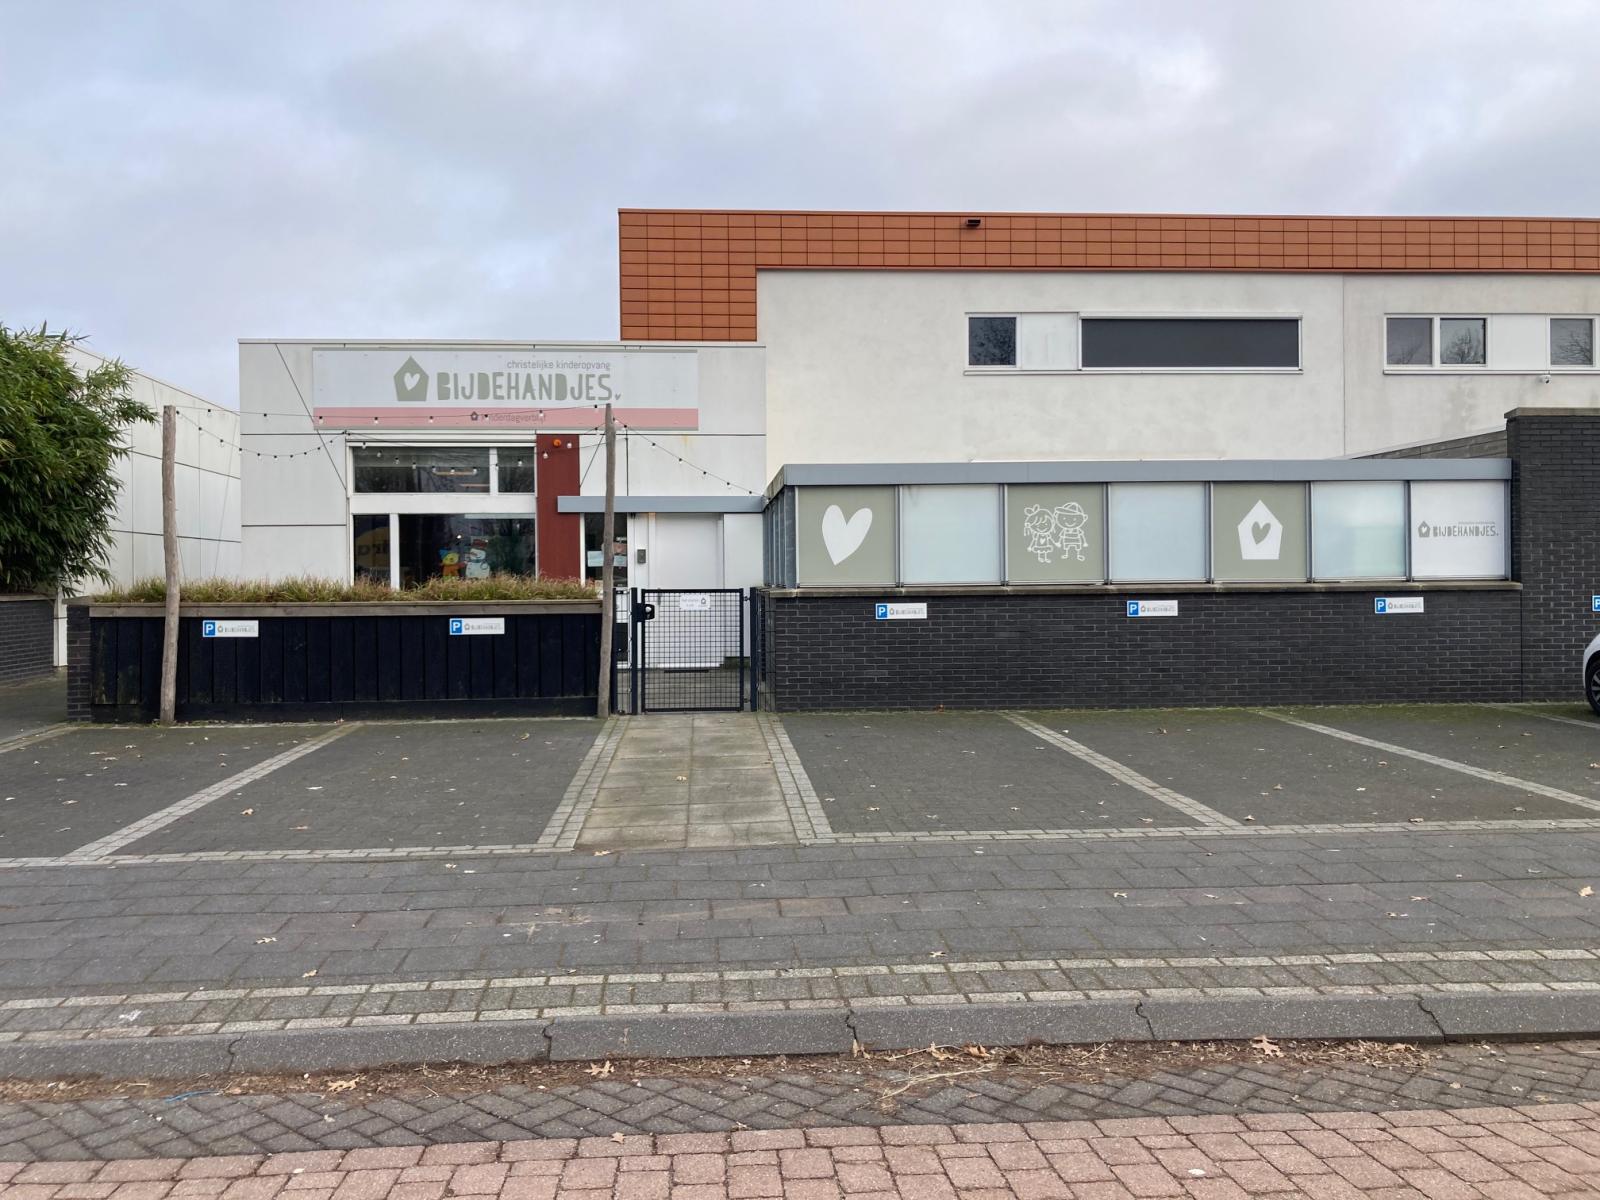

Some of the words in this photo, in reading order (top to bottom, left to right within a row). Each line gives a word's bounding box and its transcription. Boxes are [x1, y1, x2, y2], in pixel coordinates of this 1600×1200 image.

[507, 360, 553, 369] christelijke
[556, 361, 610, 370] kinderopvang
[437, 372, 612, 400] BIJDEHANDJES
[878, 606, 886, 616] P
[1130, 604, 1137, 614] P
[1378, 601, 1385, 611] P
[206, 623, 214, 634] P
[453, 622, 461, 632] P
